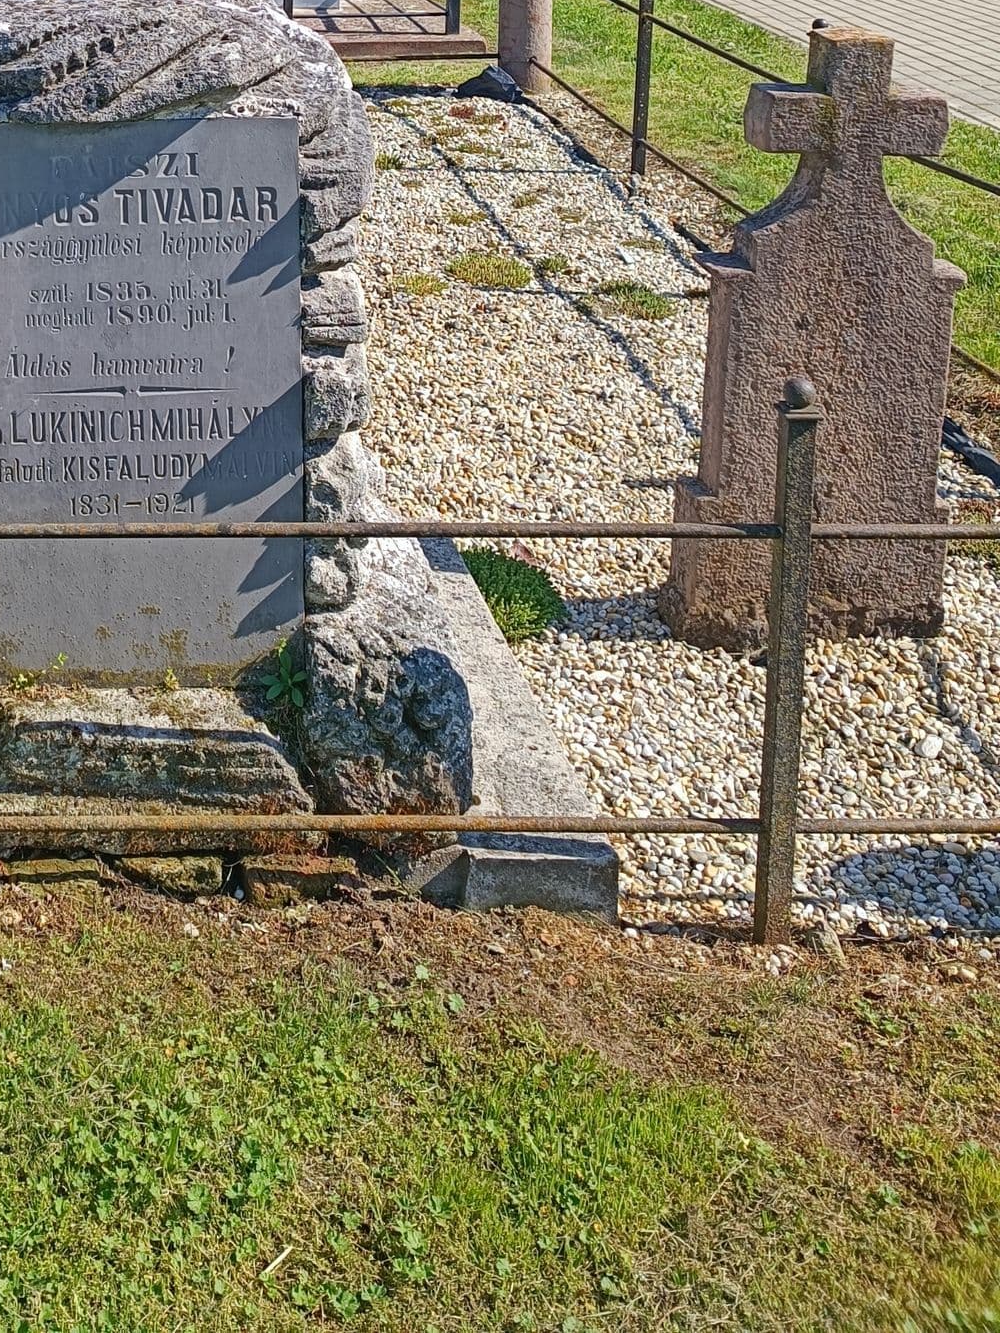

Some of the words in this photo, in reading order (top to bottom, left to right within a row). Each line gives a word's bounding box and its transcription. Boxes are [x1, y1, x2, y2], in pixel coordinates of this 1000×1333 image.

[112, 185, 280, 226] TIVADAR
[24, 306, 95, 334] meghalt
[10, 409, 146, 445] LUKINICH
[62, 450, 197, 484] KISFALUDY
